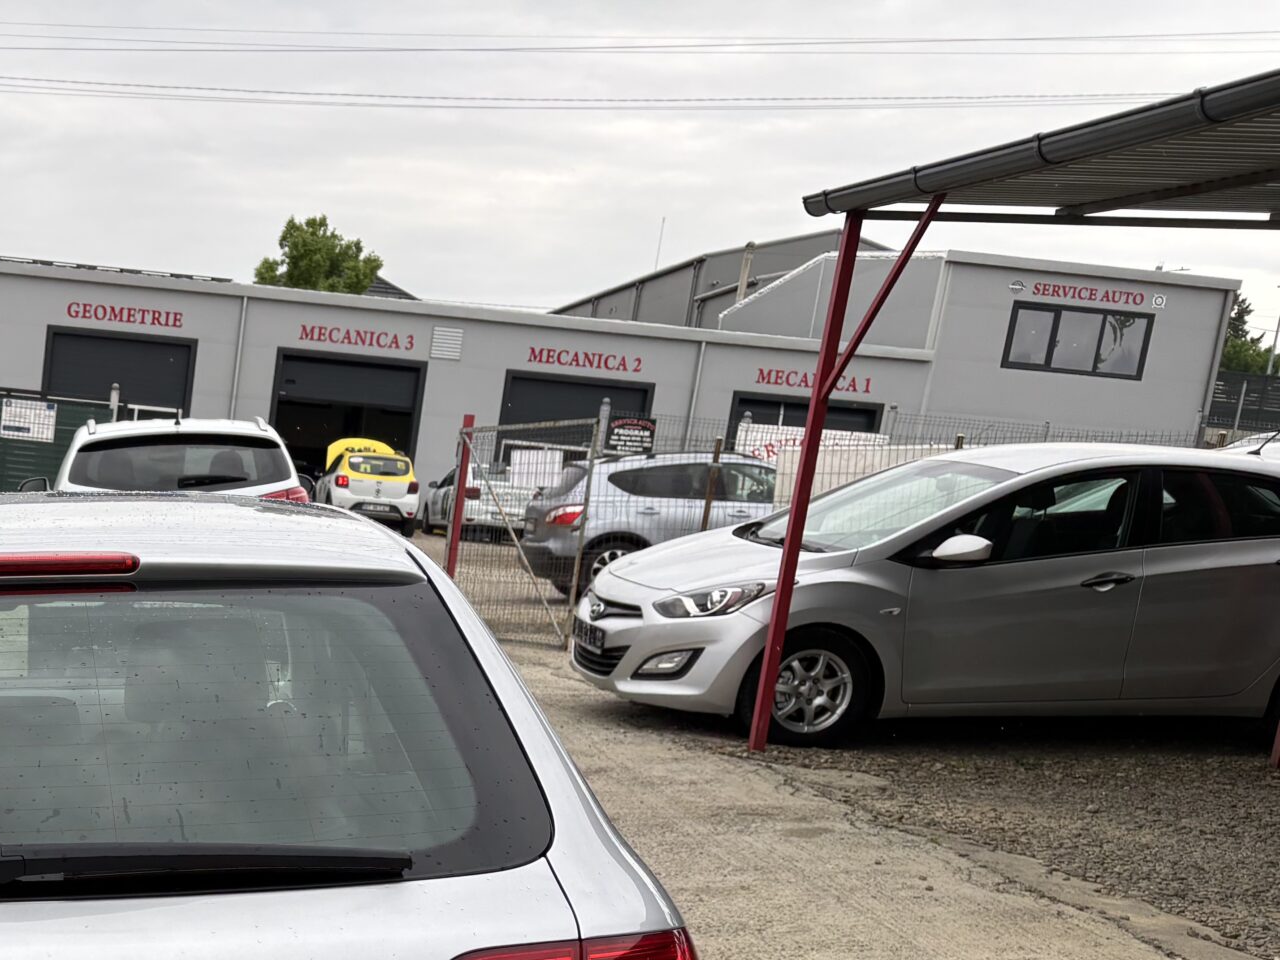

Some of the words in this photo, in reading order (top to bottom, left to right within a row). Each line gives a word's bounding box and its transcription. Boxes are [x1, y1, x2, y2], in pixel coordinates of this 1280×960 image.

[1032, 282, 1098, 301] SERVICE
[1099, 289, 1145, 306] AUTO
[67, 301, 184, 328] GEOMETRIE
[298, 324, 401, 350] MECANICA
[404, 335, 415, 351] 3
[527, 347, 629, 372] MECANICA
[632, 357, 642, 373] 2
[755, 368, 858, 393] MECACA
[862, 377, 871, 394] 1
